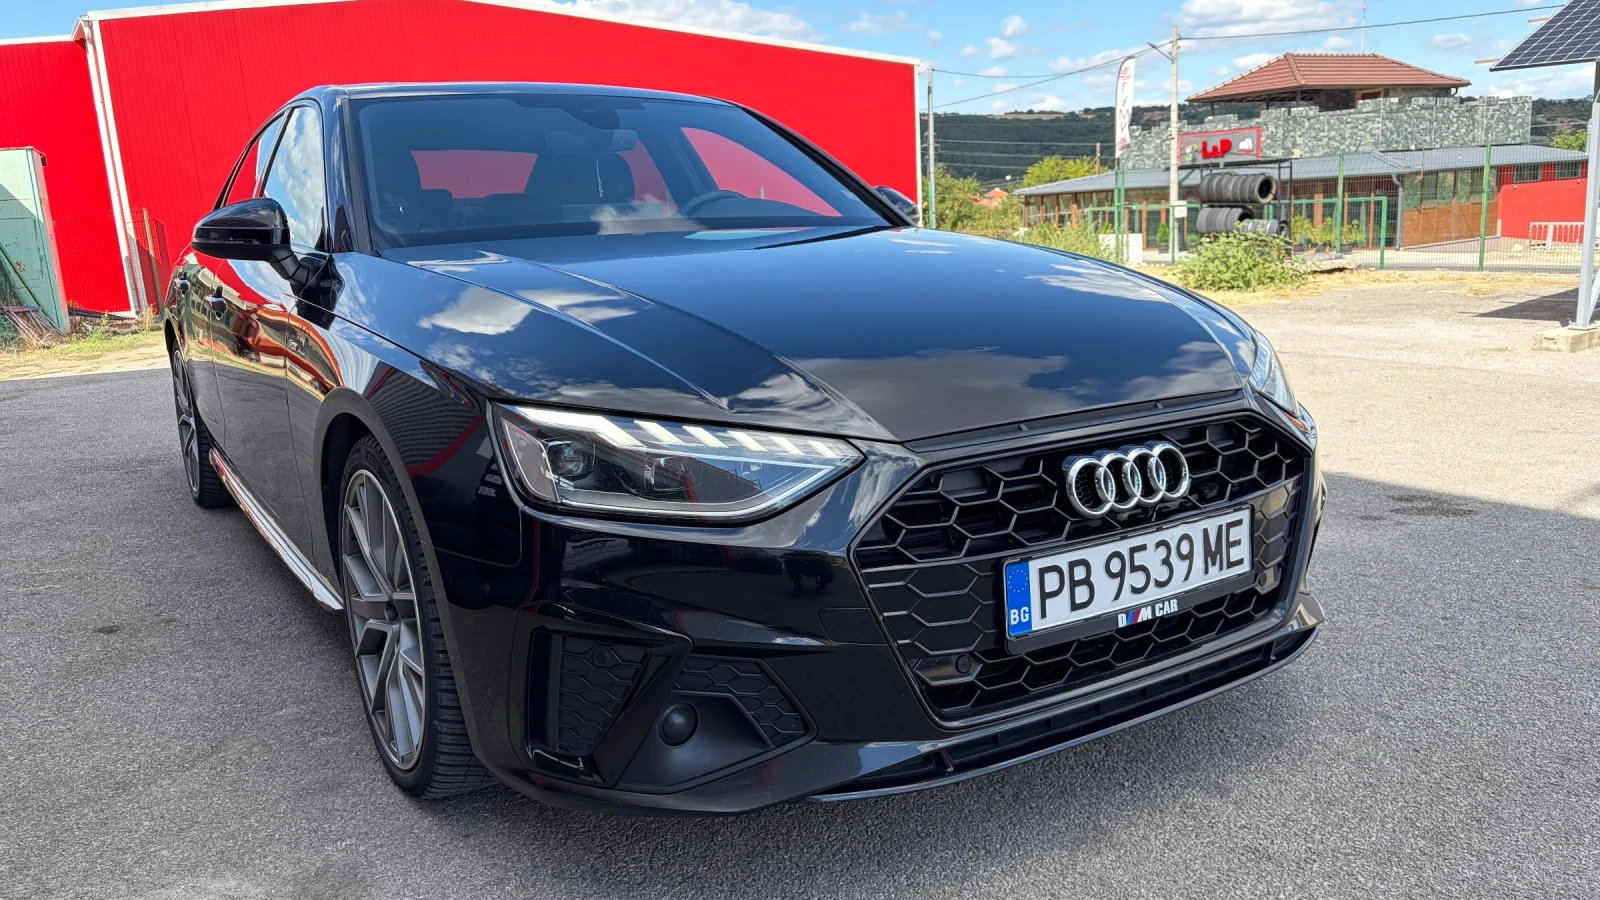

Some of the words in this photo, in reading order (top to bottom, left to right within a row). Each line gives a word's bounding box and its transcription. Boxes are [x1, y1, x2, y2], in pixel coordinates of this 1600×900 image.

[1038, 558, 1096, 620] PB
[1104, 532, 1195, 602] 9539
[1202, 518, 1245, 575] ME
[1010, 606, 1030, 626] BG
[1154, 598, 1179, 617] CAR
